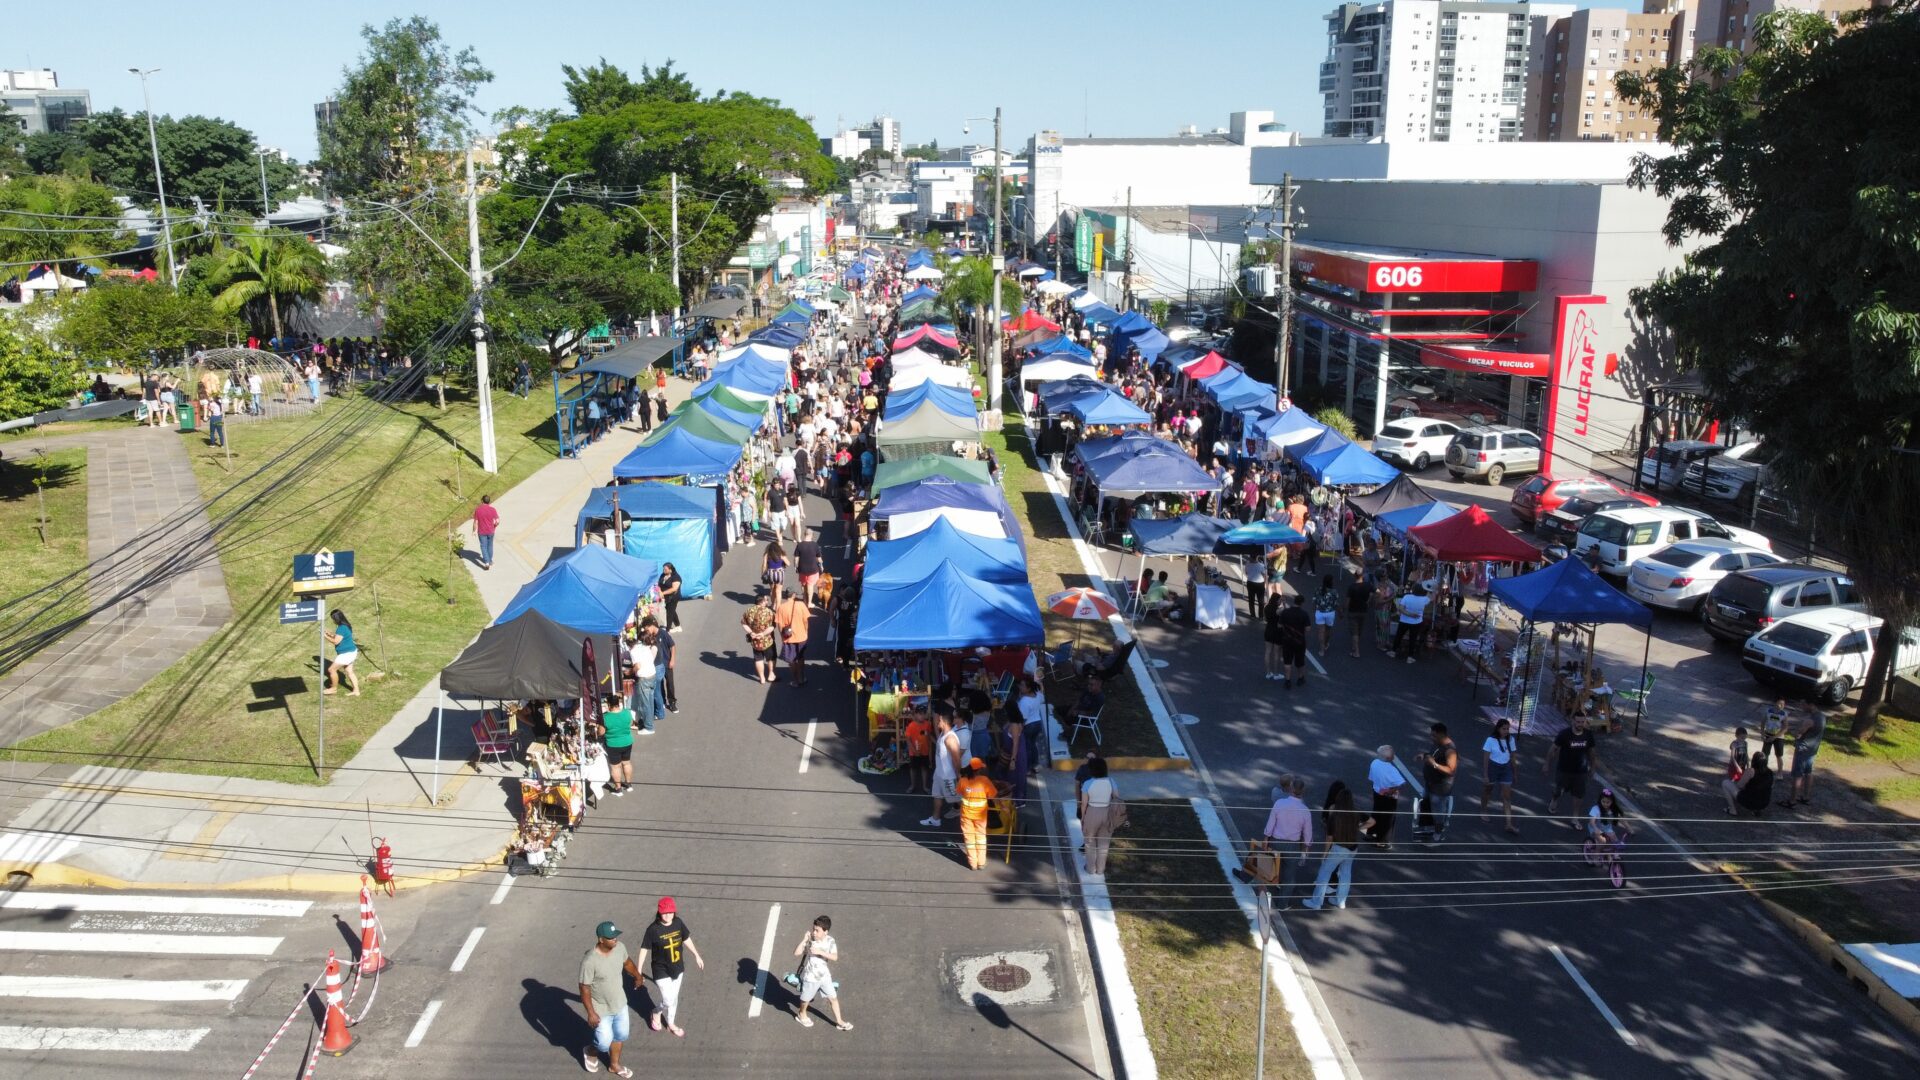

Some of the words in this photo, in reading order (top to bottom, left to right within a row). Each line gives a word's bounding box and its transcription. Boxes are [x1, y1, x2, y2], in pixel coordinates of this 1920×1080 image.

[1376, 266, 1423, 287] 606
[1498, 360, 1535, 369] VEICULOS
[1574, 335, 1595, 436] LUCRAF
[314, 565, 335, 573] NINO
